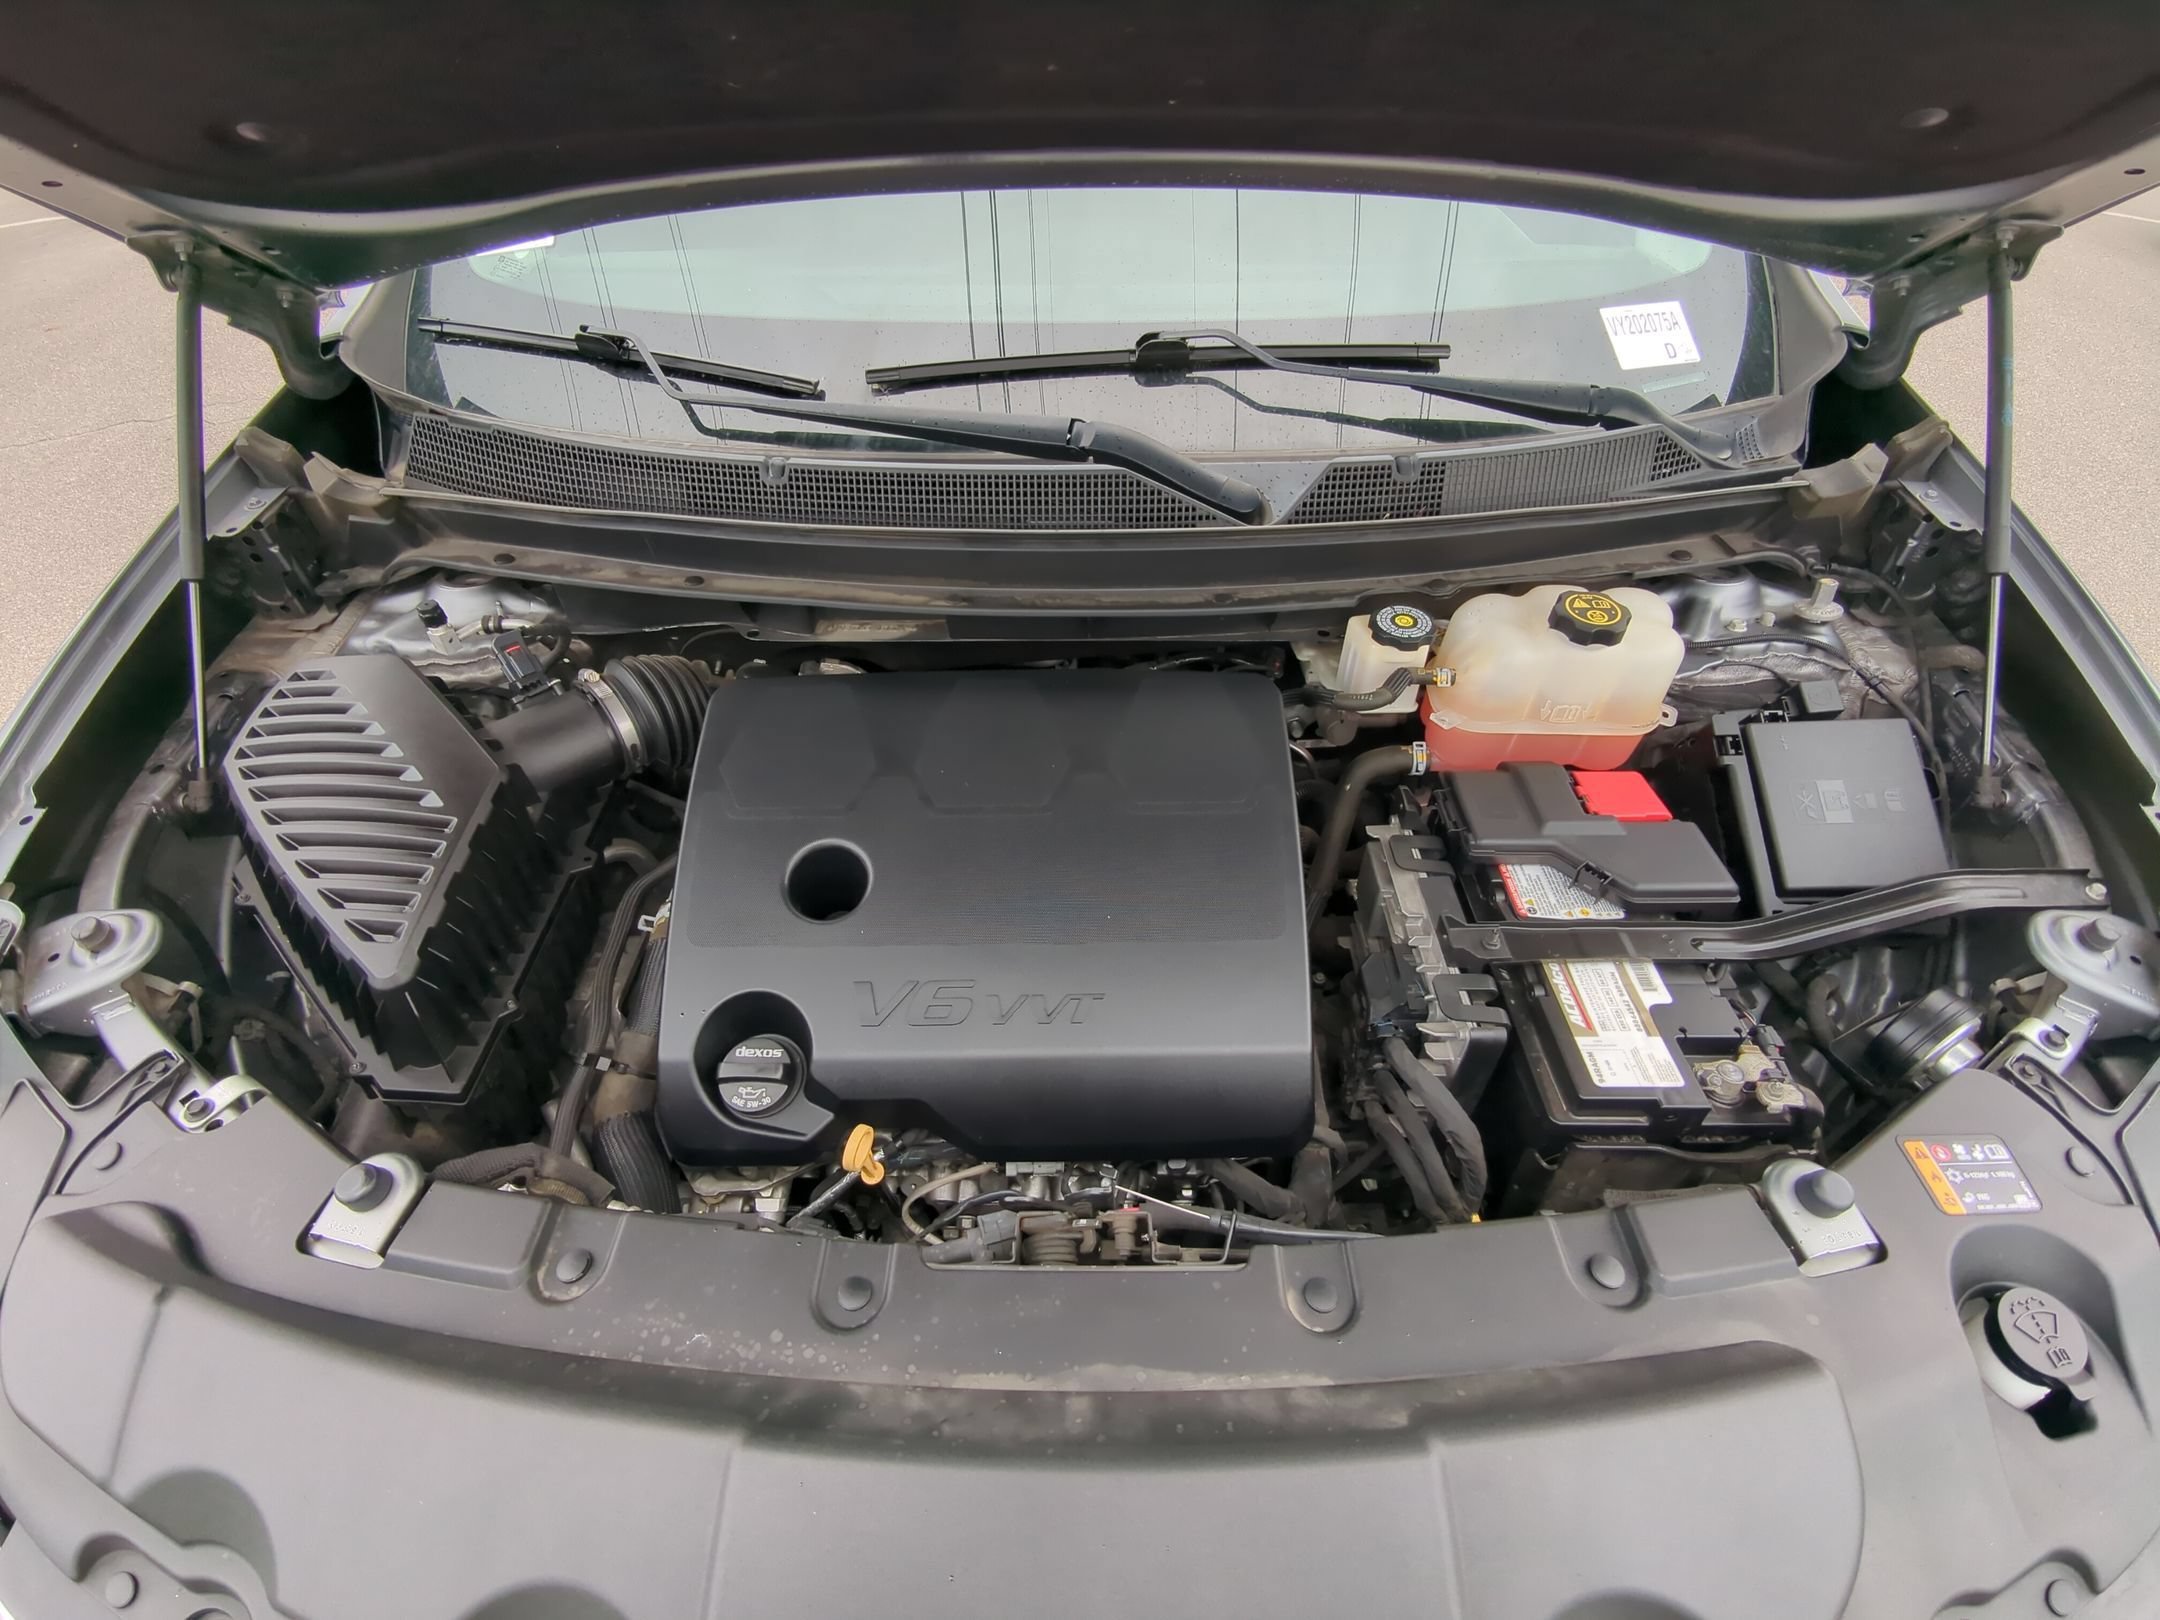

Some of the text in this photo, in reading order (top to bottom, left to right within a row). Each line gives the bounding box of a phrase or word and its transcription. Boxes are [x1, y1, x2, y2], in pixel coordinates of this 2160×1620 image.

[1606, 311, 1681, 336] VY202075A
[1664, 343, 1678, 359] D
[853, 979, 1106, 1027] V6 VVT
[1548, 962, 1587, 1029] ACDelco
[735, 1046, 785, 1058] dexos
[1586, 1051, 1606, 1084] 94RAGM
[731, 1095, 772, 1109] SAE 5W-30
